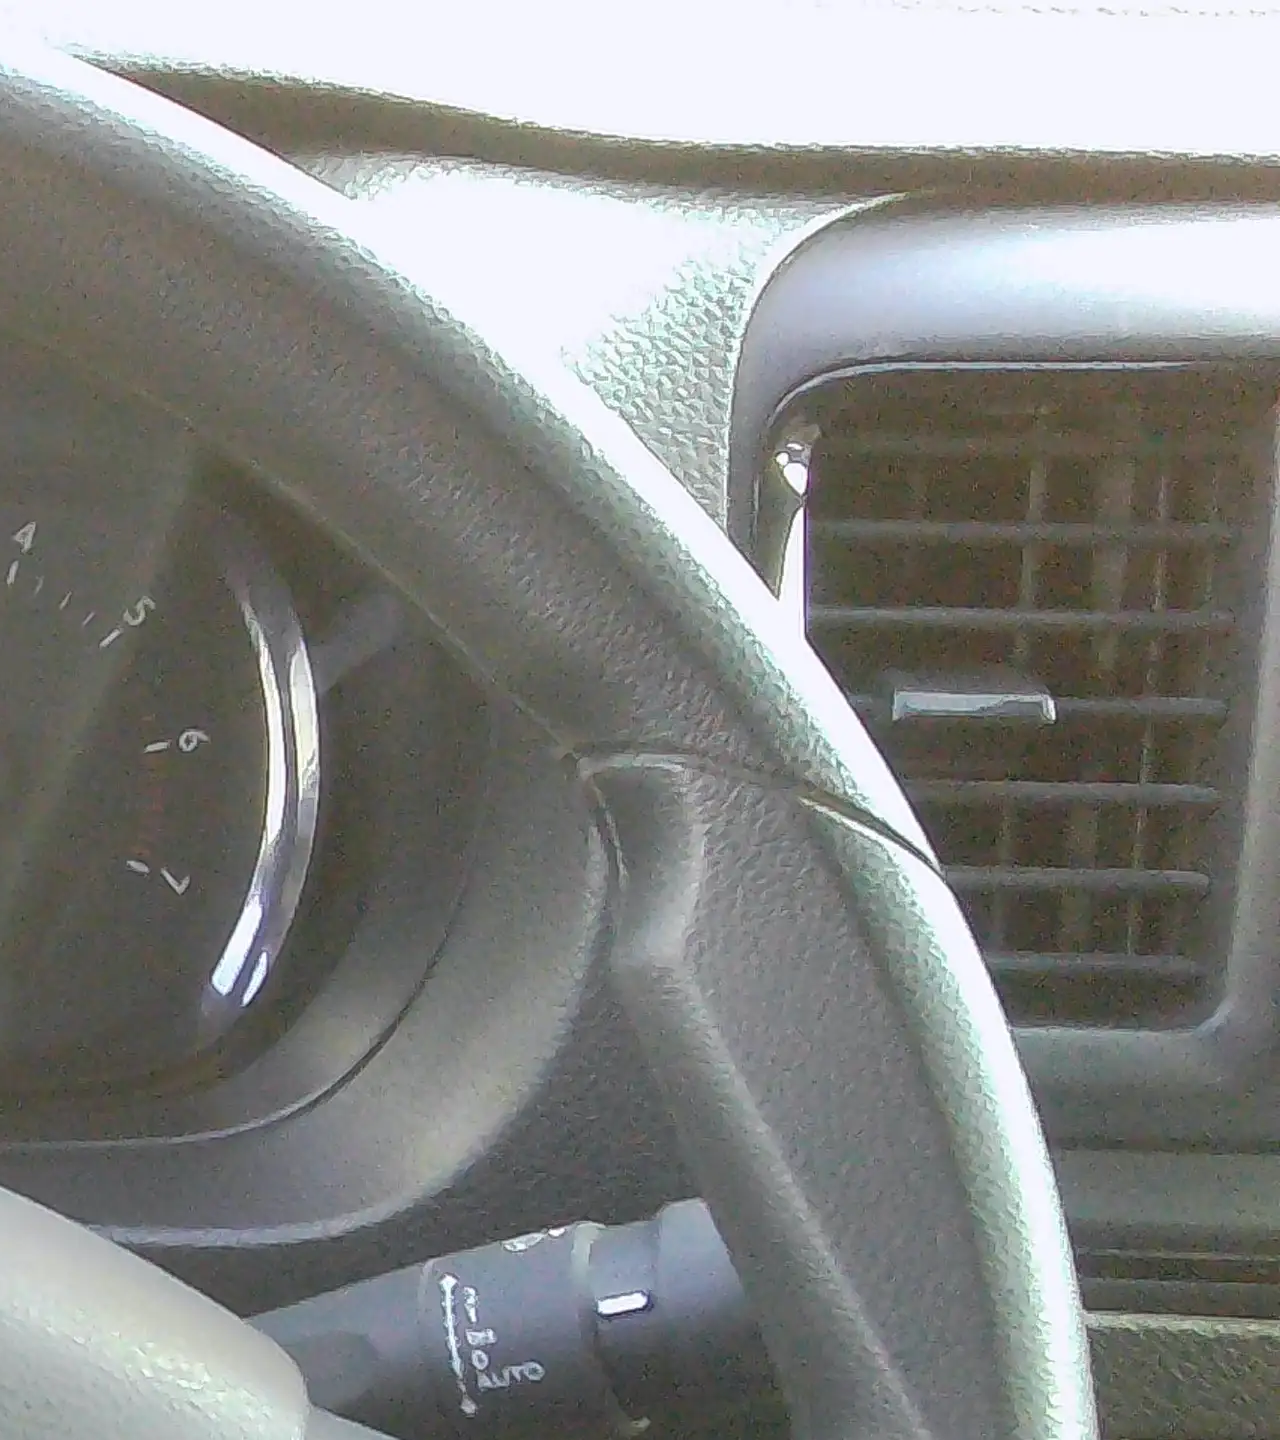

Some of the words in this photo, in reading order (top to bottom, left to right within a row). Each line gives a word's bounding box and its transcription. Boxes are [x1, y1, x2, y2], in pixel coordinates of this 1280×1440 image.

[13, 521, 36, 553] 4
[123, 595, 156, 626] 5
[178, 728, 211, 752] 6
[160, 867, 191, 895] 7
